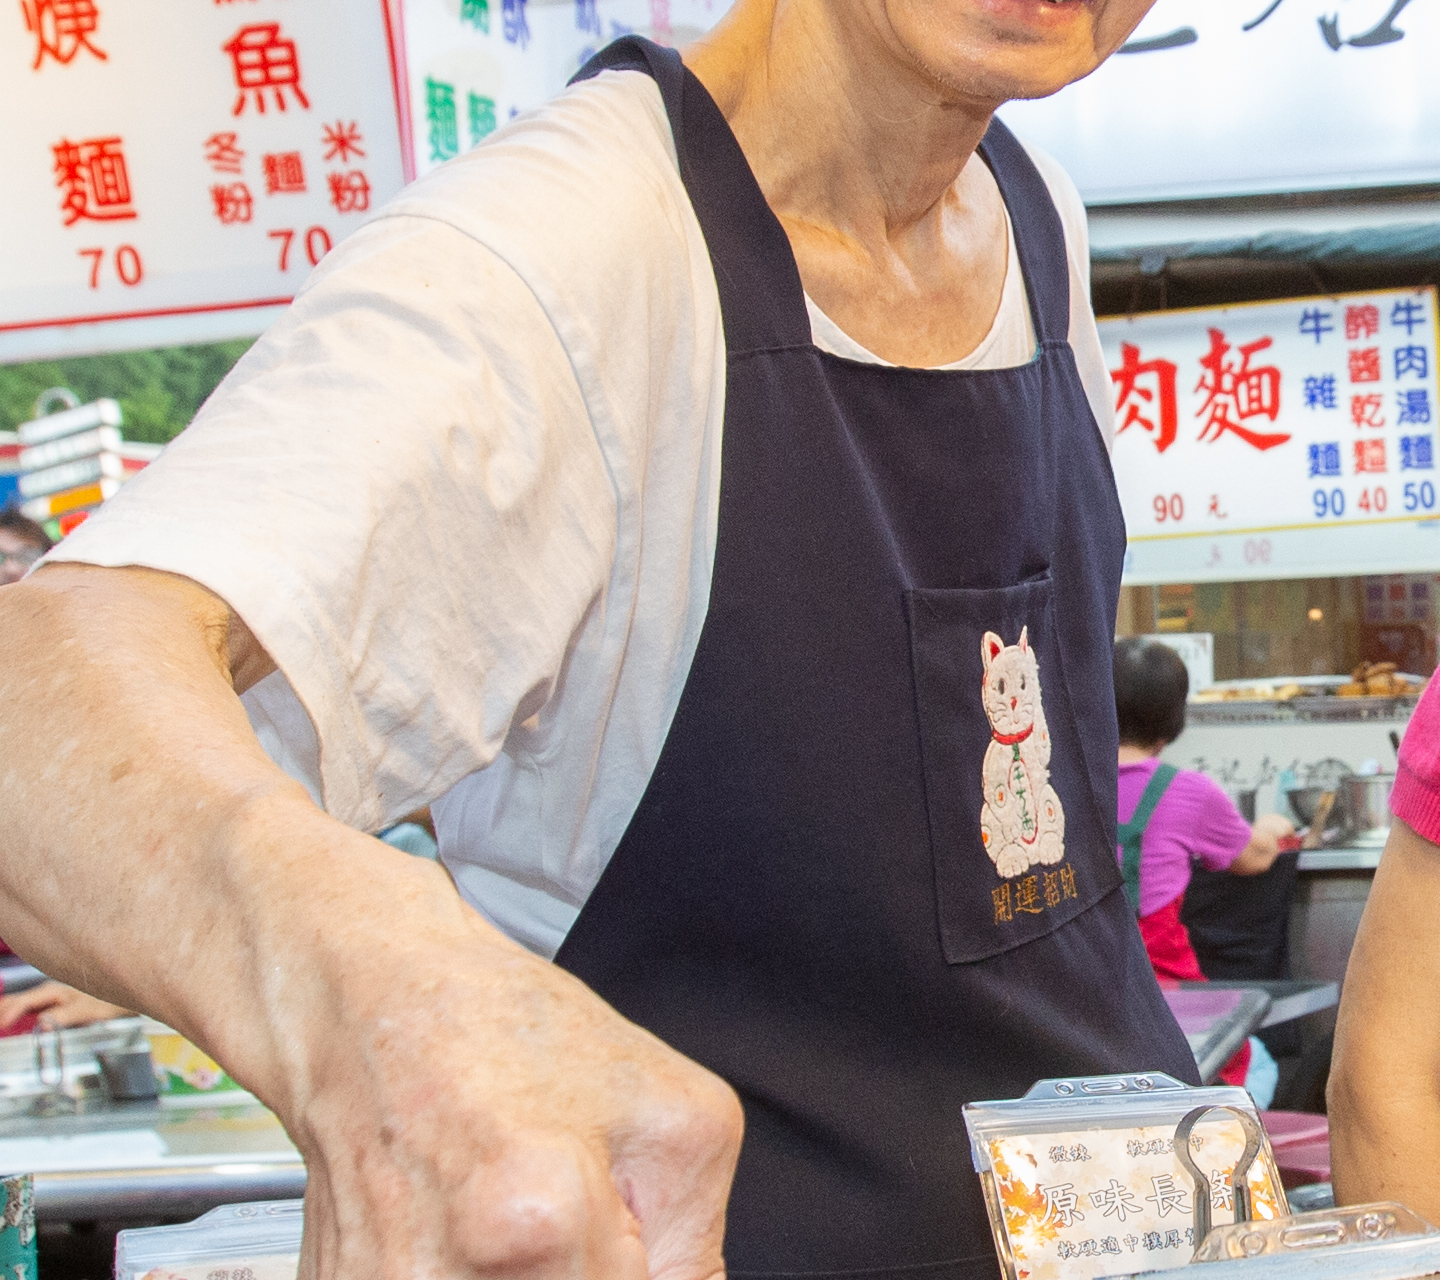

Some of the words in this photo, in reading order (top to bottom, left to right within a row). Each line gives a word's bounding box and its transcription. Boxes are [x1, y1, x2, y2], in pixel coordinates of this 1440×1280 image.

[321, 120, 371, 215] 米粉
[79, 244, 144, 291] 70
[269, 225, 334, 273] 70
[1111, 326, 1292, 454] 肉麵
[1390, 297, 1434, 472] 牛肉湯麵
[1152, 493, 1185, 523] 90
[1312, 487, 1346, 519] 90
[1357, 486, 1388, 513] 40
[1403, 480, 1436, 512] 50
[1048, 1142, 1093, 1164] 微辣
